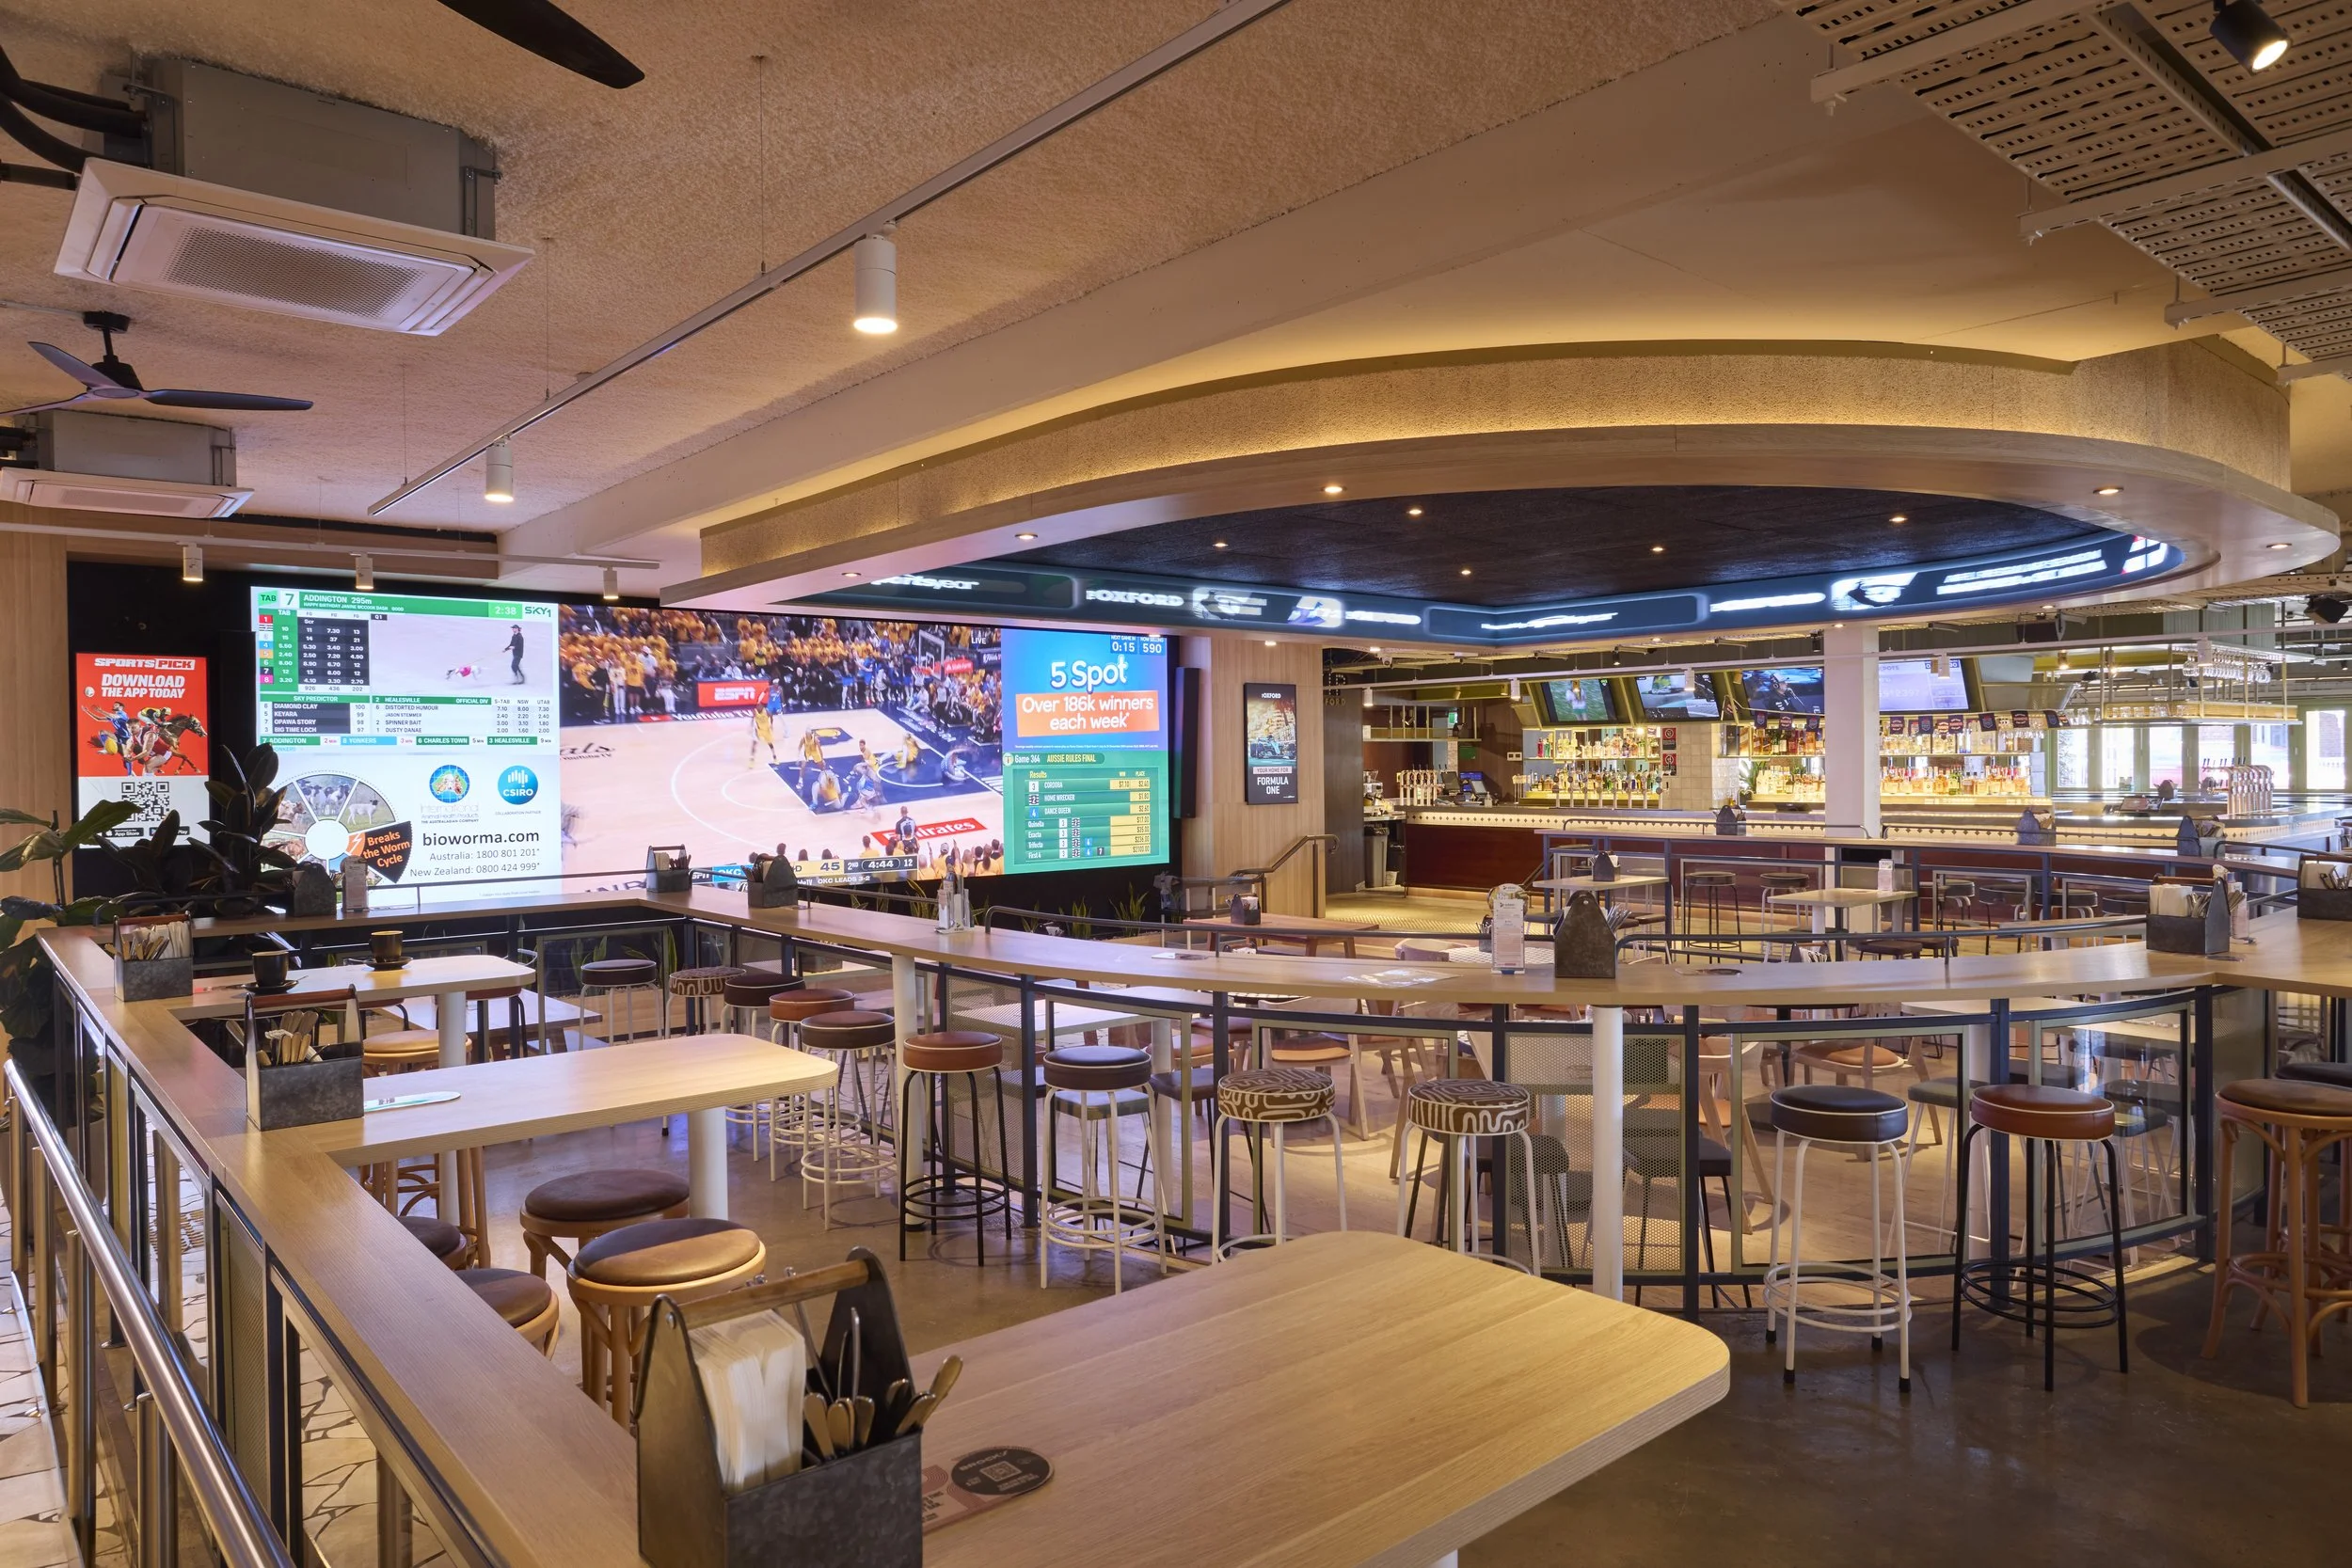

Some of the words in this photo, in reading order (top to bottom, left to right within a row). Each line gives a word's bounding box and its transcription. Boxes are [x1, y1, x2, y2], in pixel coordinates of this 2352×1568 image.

[285, 593, 294, 606] 7
[304, 594, 347, 604] ADDINGTON
[352, 596, 372, 605] 295m
[495, 606, 516, 615] 2:38
[1112, 641, 1135, 652] 0:15
[1143, 643, 1162, 653] 590
[94, 657, 155, 668] SPORTS
[156, 659, 193, 669] PICK
[1051, 661, 1067, 688] 5
[1071, 655, 1128, 693] Spot
[102, 673, 185, 688] DOWNLOAD
[102, 688, 125, 697] THE
[126, 688, 148, 698] APP
[149, 689, 185, 698] TODAY
[714, 687, 755, 701] ESPN
[1022, 696, 1059, 713] Over
[1064, 694, 1095, 712] 186k
[1099, 694, 1154, 710] winners
[1050, 716, 1086, 731] each
[1015, 754, 1029, 763] Game
[1066, 754, 1081, 763] RULES
[1257, 776, 1288, 785] FORMULA
[502, 788, 533, 797] CSIRO
[883, 821, 976, 841] Eirates
[367, 832, 401, 847] Breaks
[422, 832, 539, 847] bioworma.com
[363, 848, 380, 859] the
[380, 841, 410, 854] Worm
[429, 850, 473, 861] Australia:
[476, 849, 499, 860] 1800
[501, 849, 517, 858] 801
[376, 854, 403, 867] Cycle
[848, 862, 859, 870] 2ND
[867, 860, 894, 868] 4:44
[903, 859, 914, 867] 12
[410, 867, 433, 878] New
[434, 865, 473, 876] Zealand:
[476, 864, 499, 874] 0800
[501, 863, 517, 872] 424
[820, 863, 839, 871] 45
